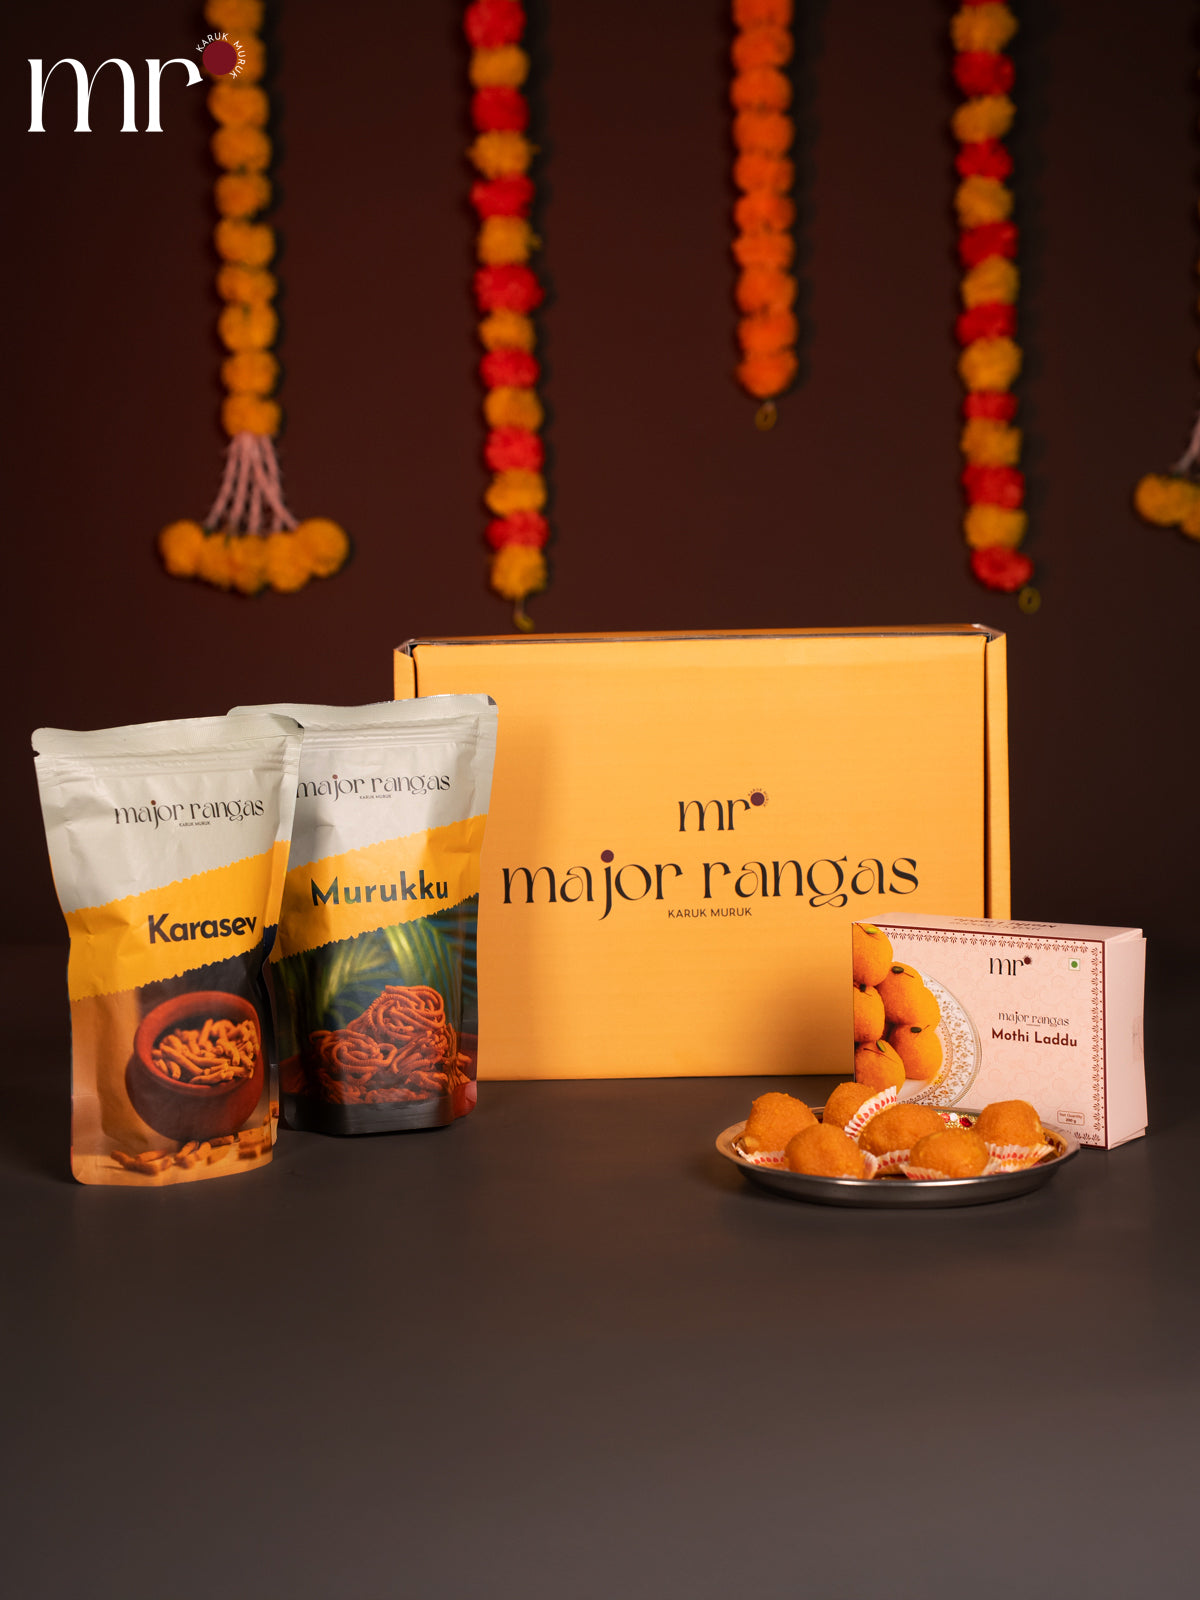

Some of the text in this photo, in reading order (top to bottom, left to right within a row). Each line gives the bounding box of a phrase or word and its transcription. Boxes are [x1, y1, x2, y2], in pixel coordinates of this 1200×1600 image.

[296, 774, 451, 802] major rangas
[114, 800, 265, 830] major rangas
[678, 799, 751, 832] mr
[311, 870, 448, 906] Murukku
[503, 850, 920, 921] major rangas
[668, 907, 752, 918] KARUK MURUK
[148, 913, 257, 944] Karasev
[990, 957, 1024, 976] mr
[998, 1011, 1070, 1027] major rangas
[992, 1027, 1078, 1047] Mothi Laddu
